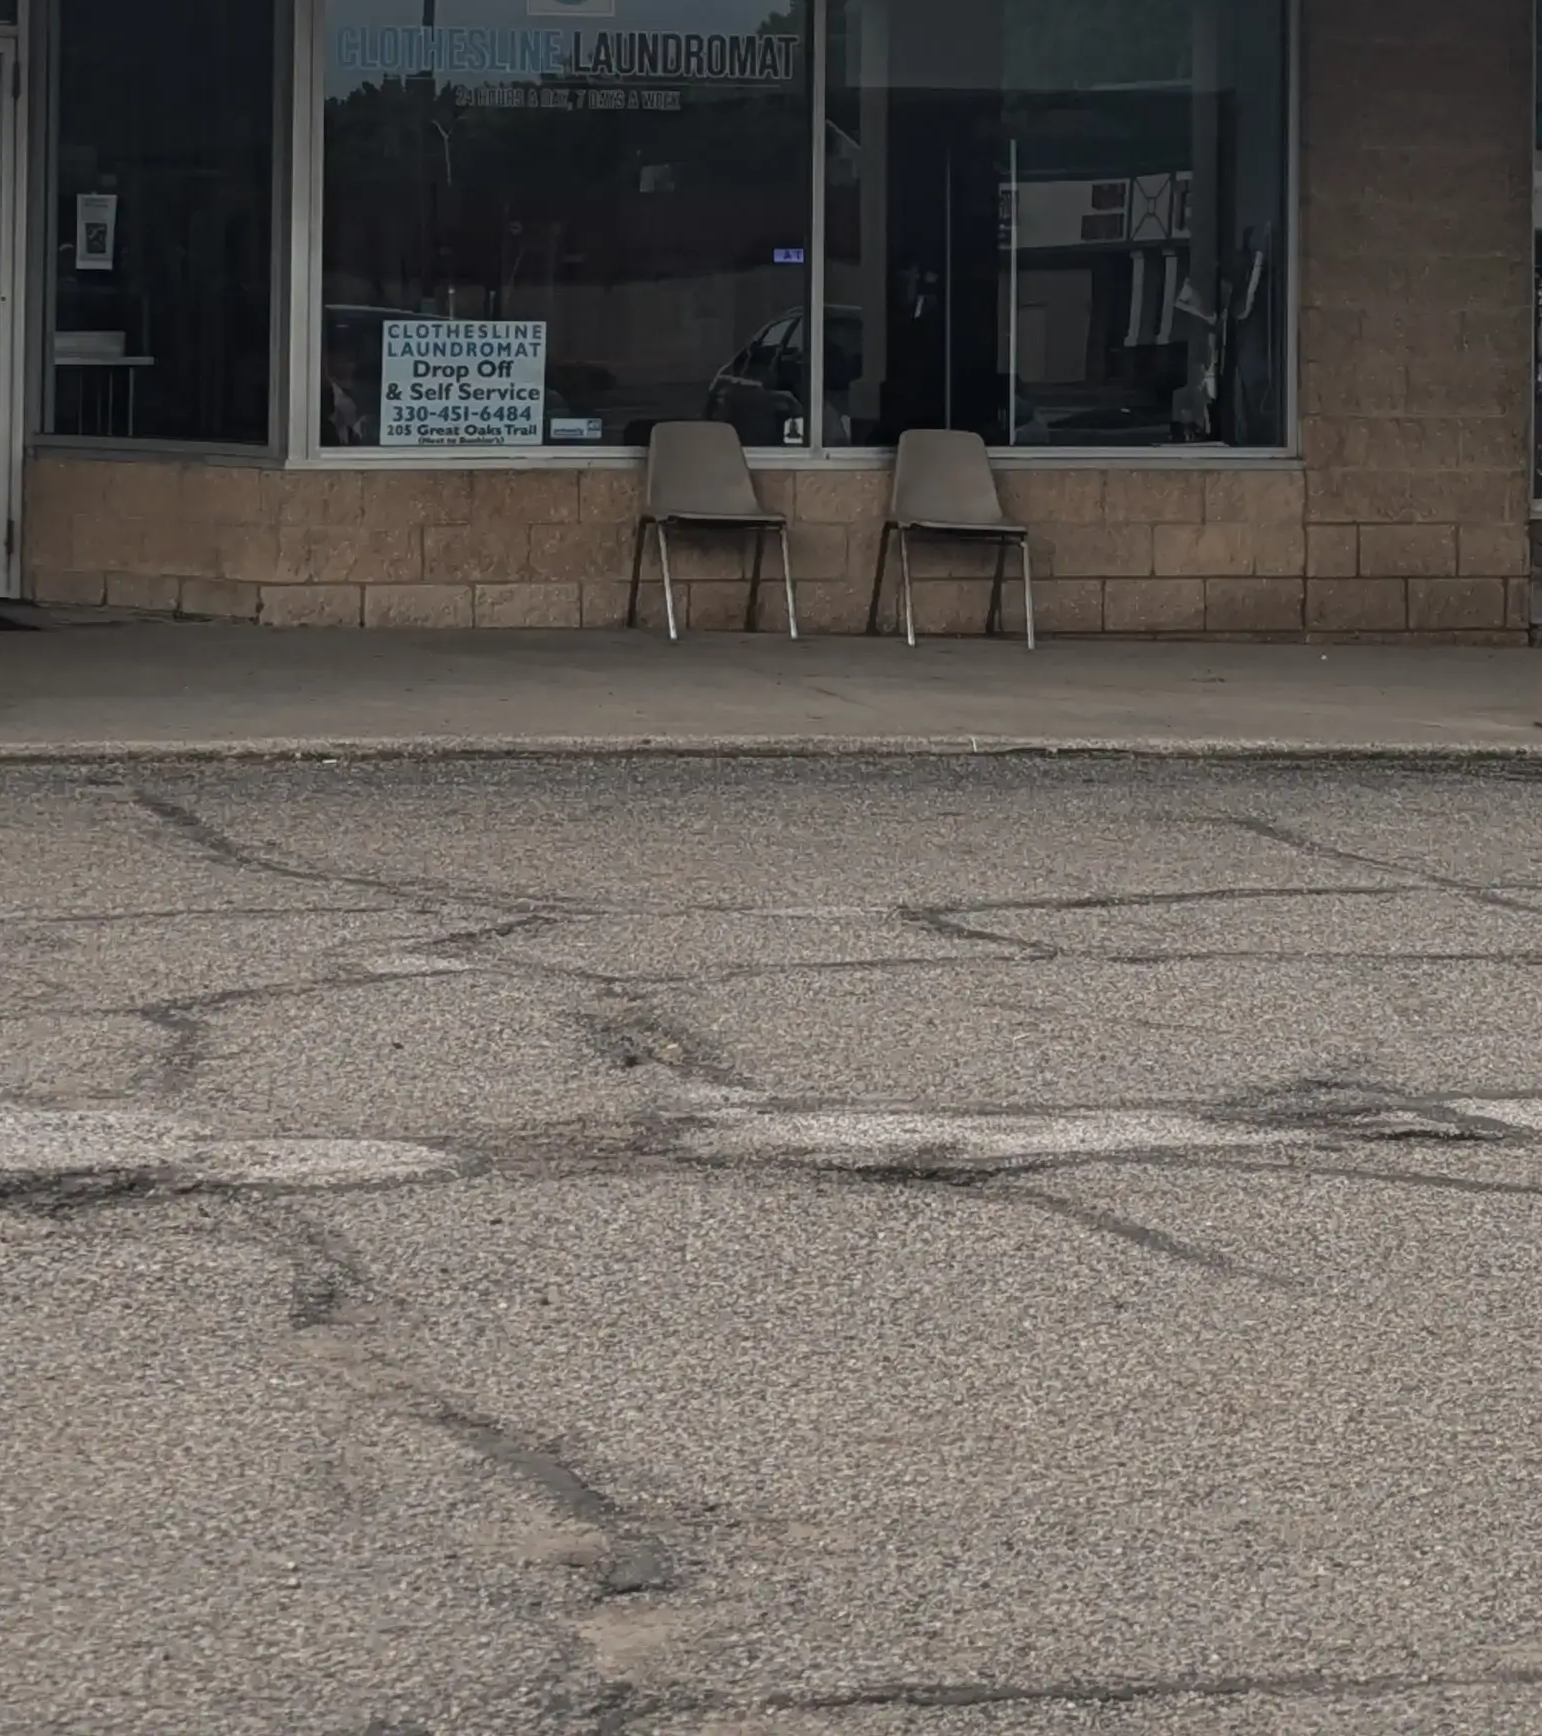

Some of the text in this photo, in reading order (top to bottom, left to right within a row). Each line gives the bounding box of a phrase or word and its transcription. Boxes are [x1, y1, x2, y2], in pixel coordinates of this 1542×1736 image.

[336, 25, 799, 80] CLOTHESLINE LAUNDROMAT
[588, 89, 625, 110] DAYS
[387, 324, 542, 340] CLOTHESLINE
[387, 341, 541, 358] LAUNDROMAT
[413, 360, 515, 383] Drop Off
[385, 382, 541, 401] & Self Service
[393, 405, 532, 422] 330-451-6484
[387, 424, 537, 436] 205 Great Oaks Trail
